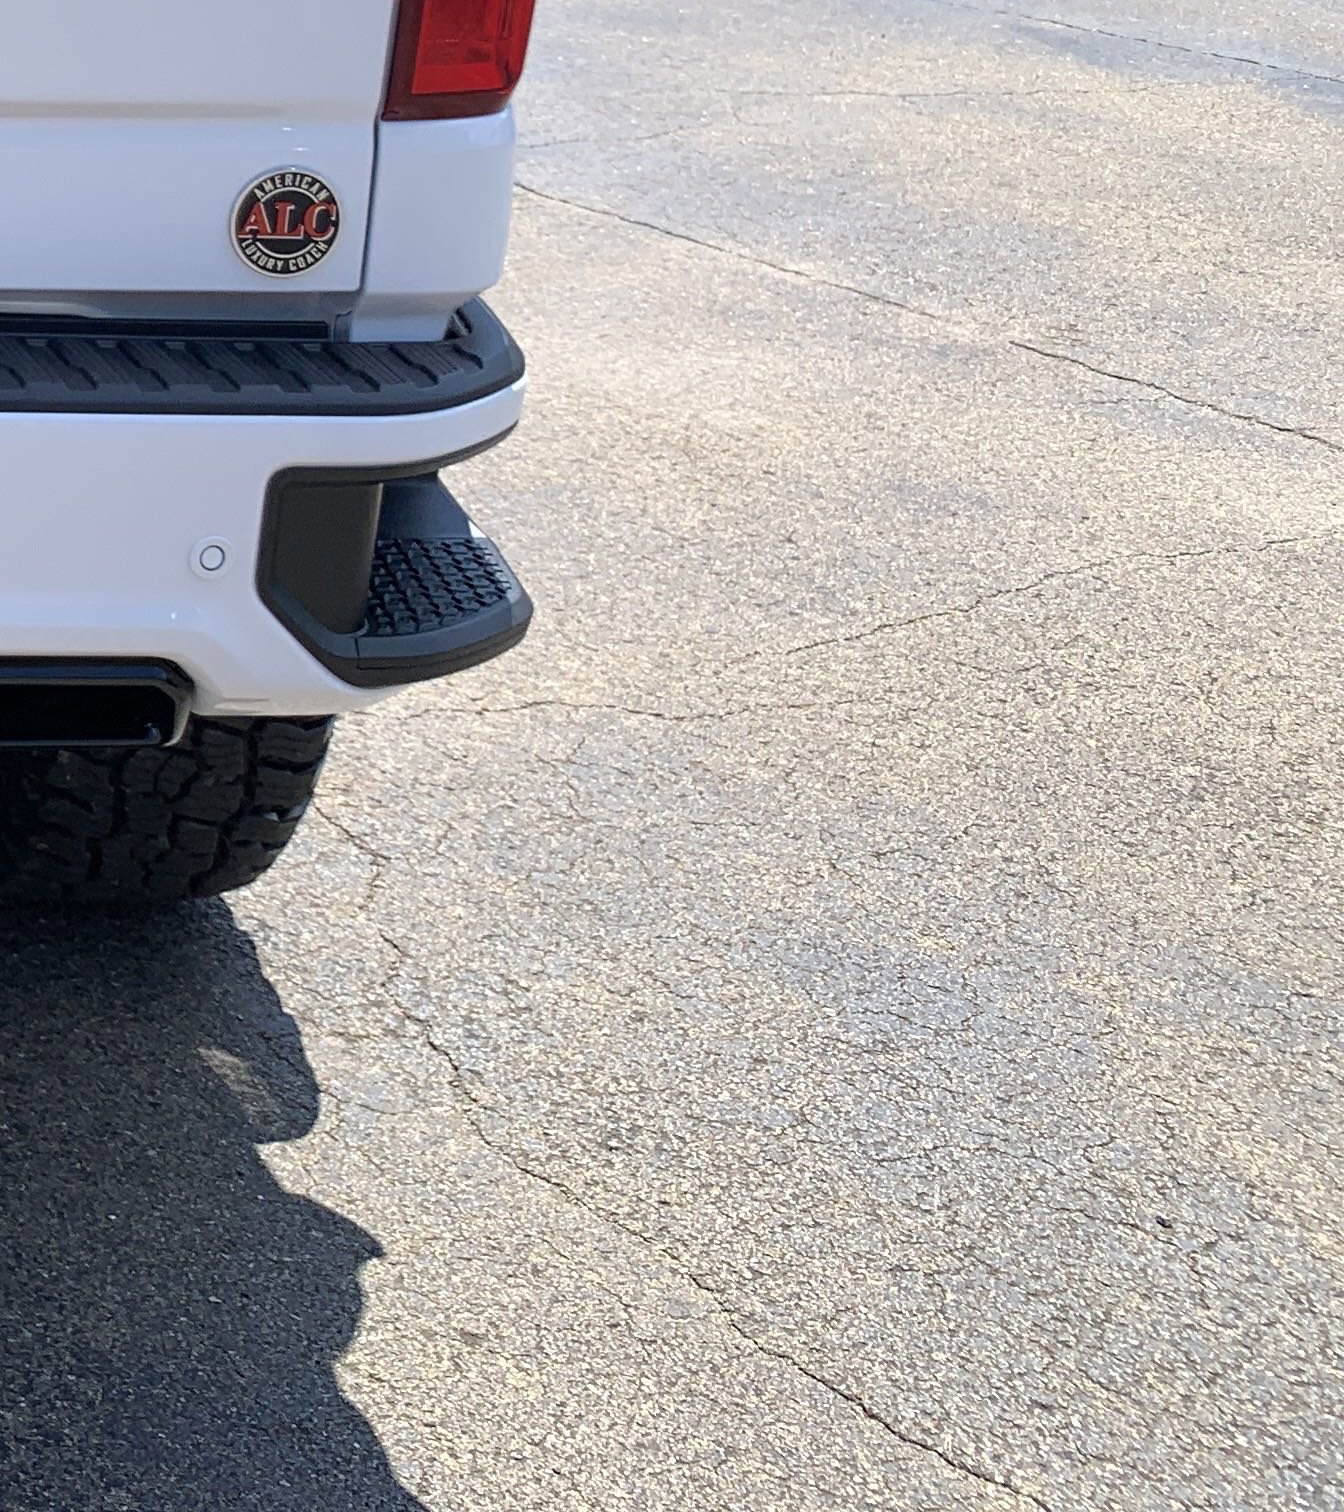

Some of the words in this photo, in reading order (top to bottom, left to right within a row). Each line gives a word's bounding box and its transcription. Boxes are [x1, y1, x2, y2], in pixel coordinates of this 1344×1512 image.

[253, 173, 329, 201] AMERICAN
[236, 200, 337, 241] ALC
[241, 239, 284, 271] LUXURY
[288, 241, 328, 271] COACH
